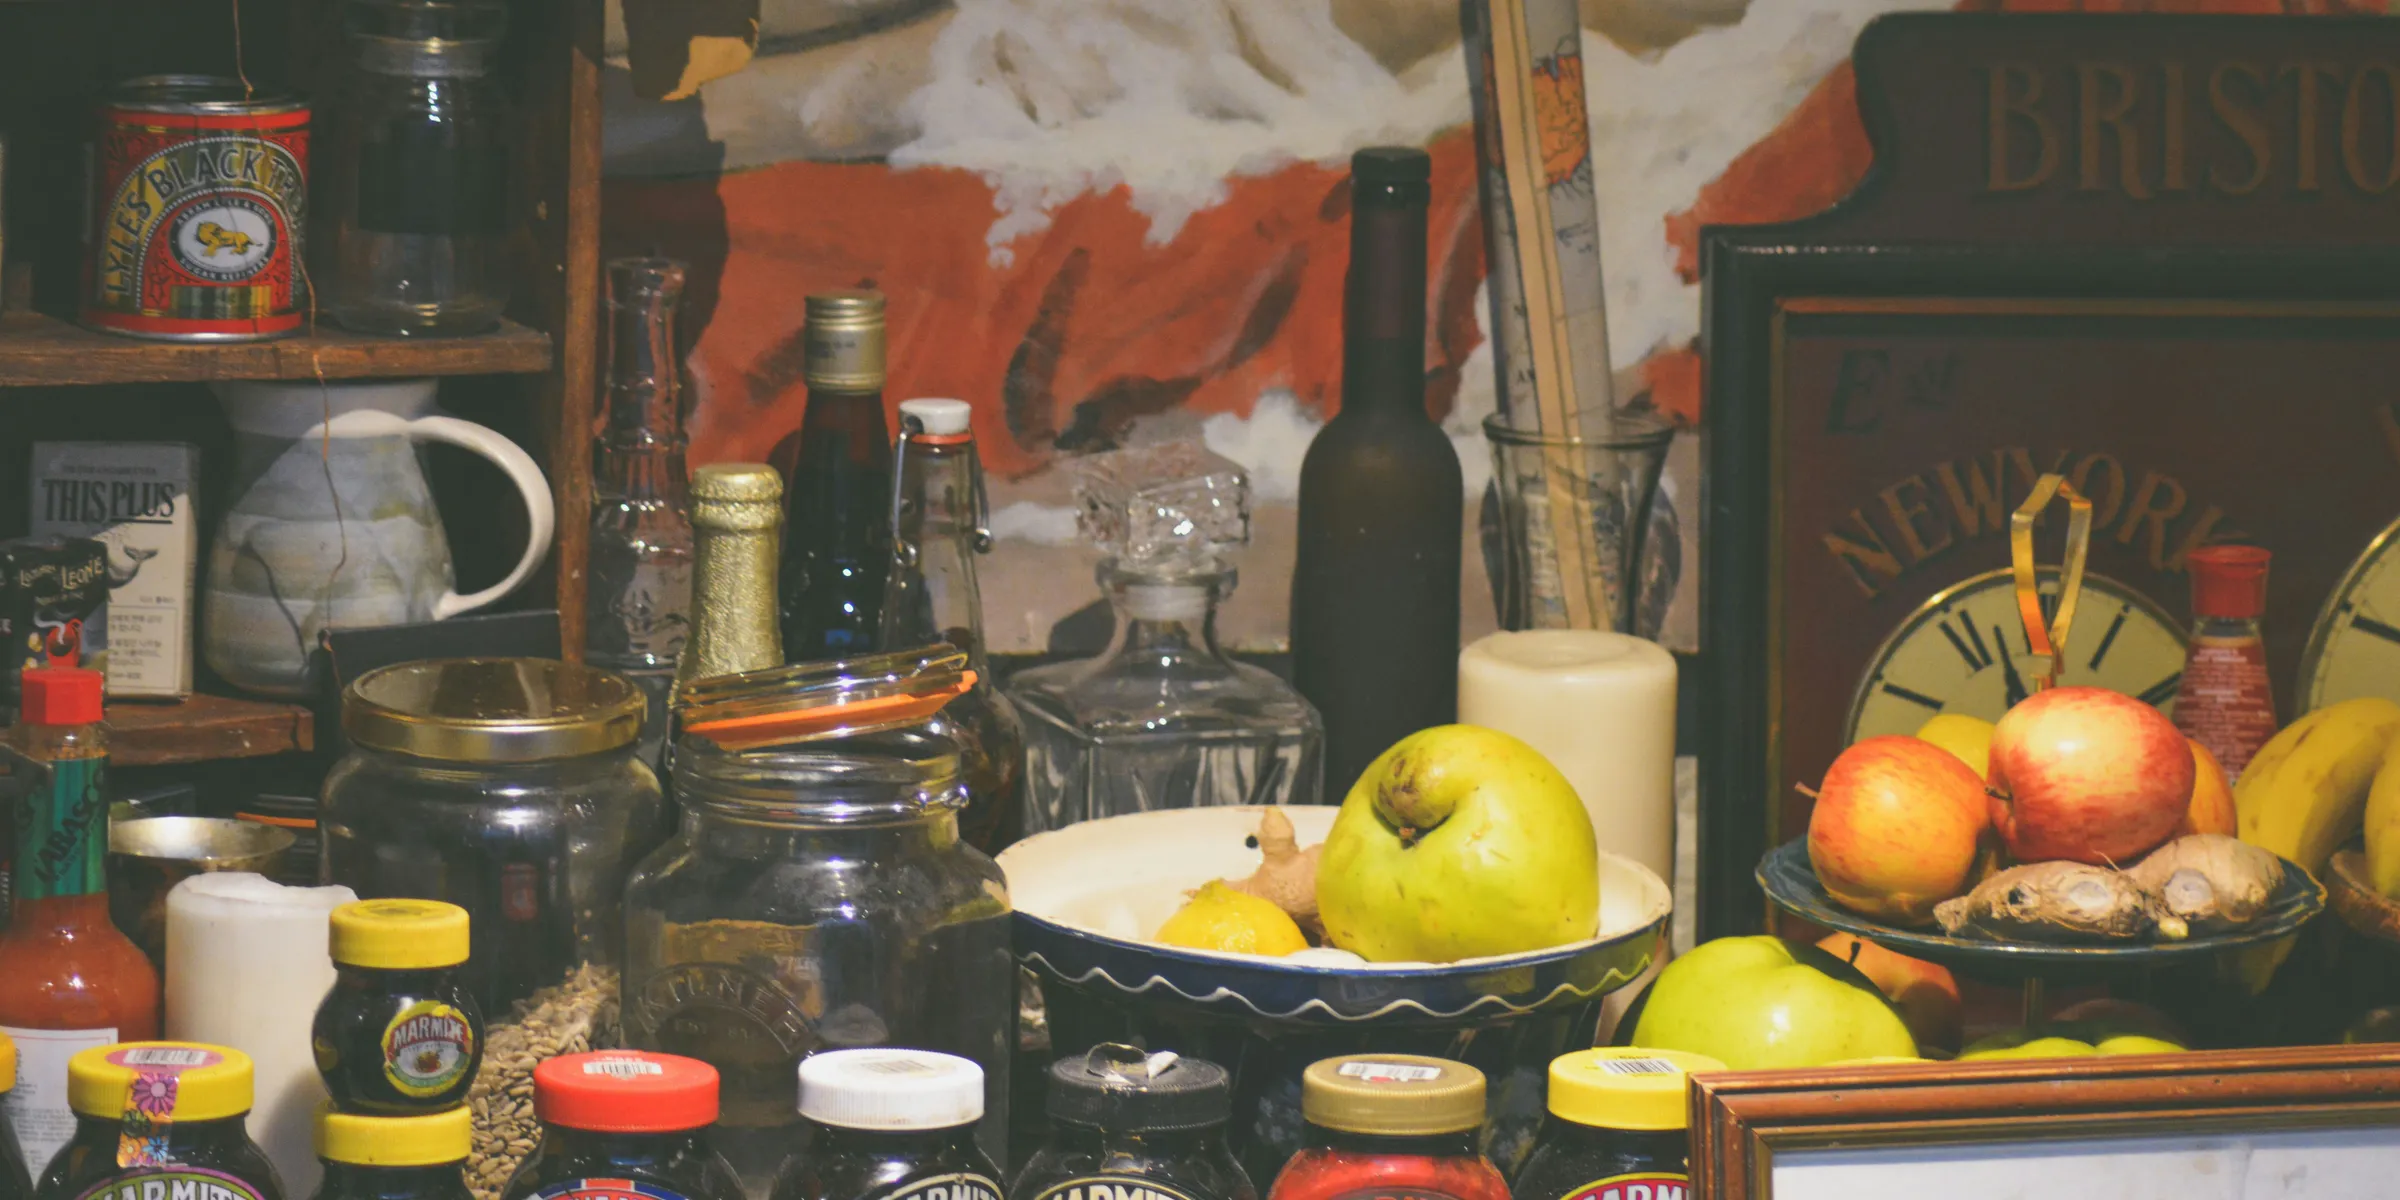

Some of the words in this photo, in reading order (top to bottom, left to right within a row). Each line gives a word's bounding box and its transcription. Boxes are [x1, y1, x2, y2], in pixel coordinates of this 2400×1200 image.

[146, 147, 267, 202] BLACK
[41, 478, 107, 526] THIS
[110, 480, 176, 518] PLUS
